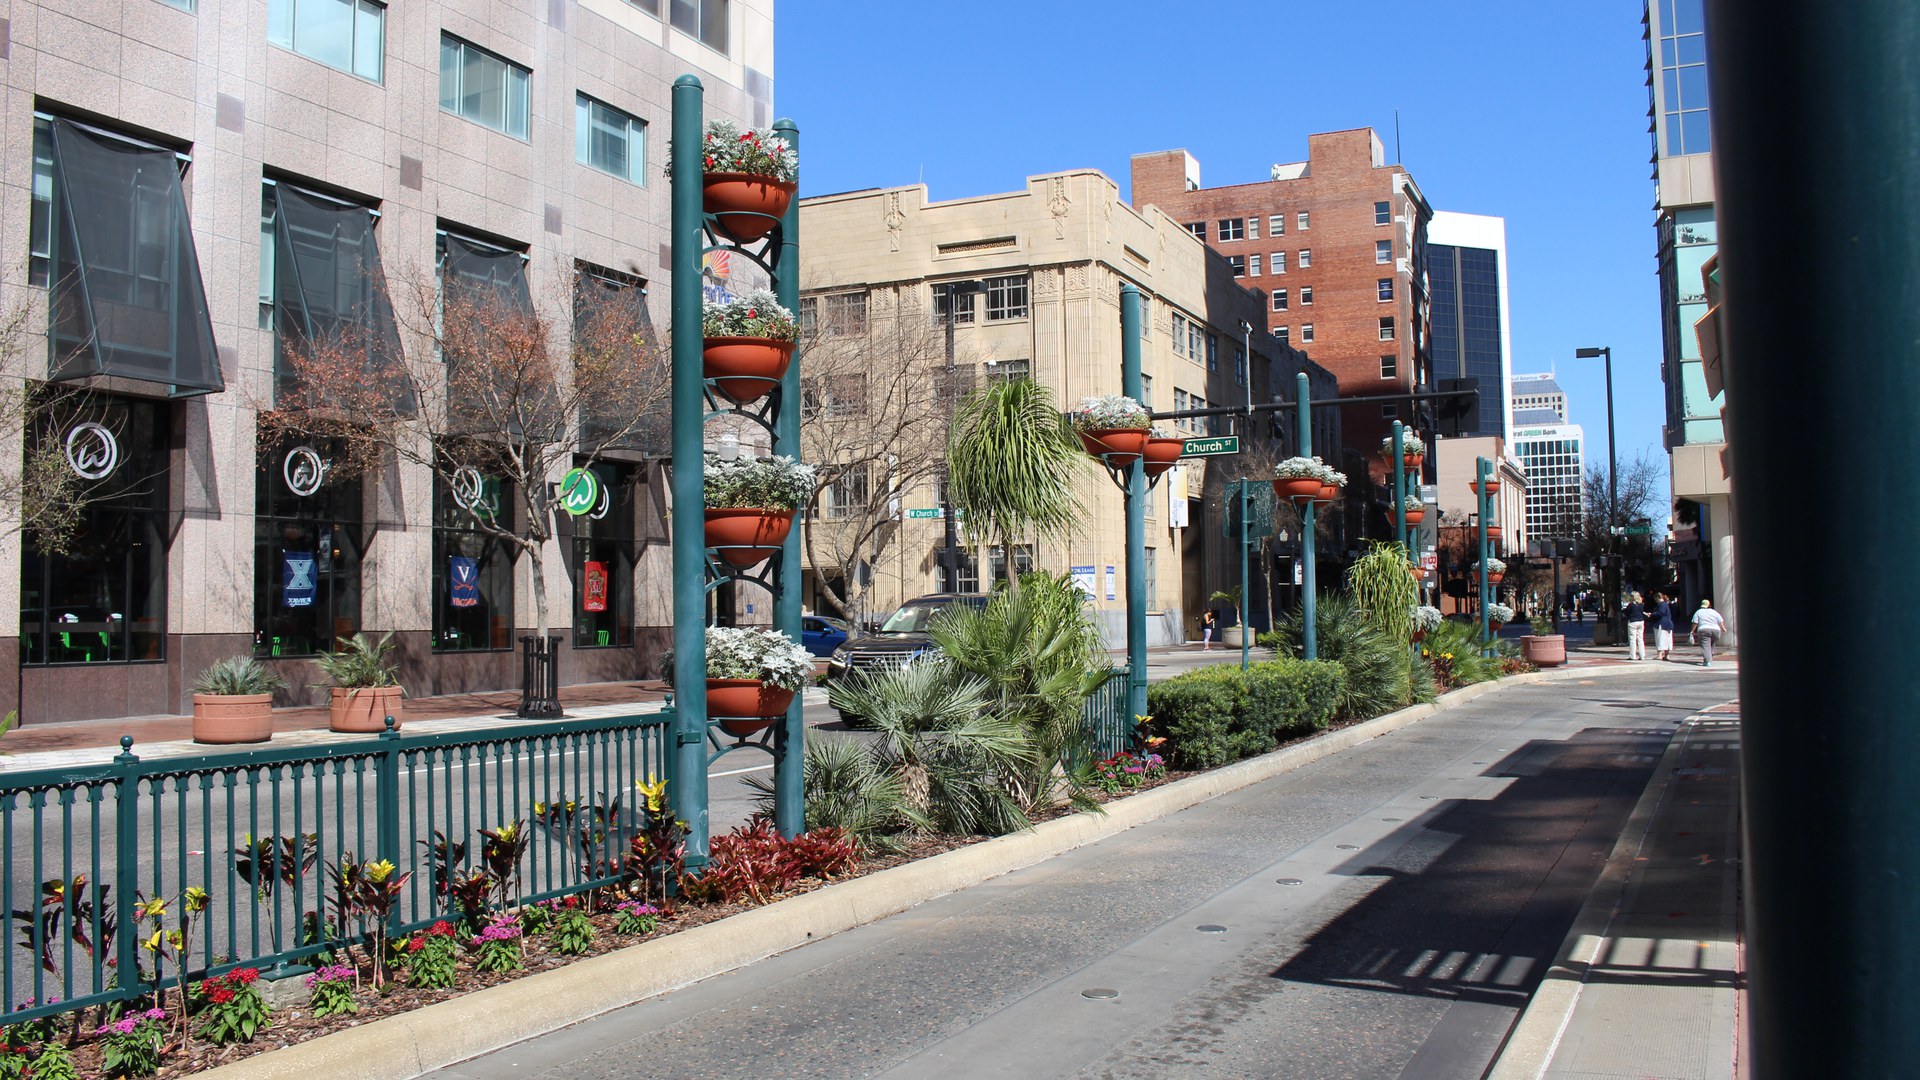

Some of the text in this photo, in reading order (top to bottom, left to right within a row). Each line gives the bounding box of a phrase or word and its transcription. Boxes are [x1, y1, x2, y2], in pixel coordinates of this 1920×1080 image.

[1186, 441, 1222, 453] Church
[916, 509, 933, 518] Church
[286, 559, 314, 590] X
[457, 565, 470, 582] V
